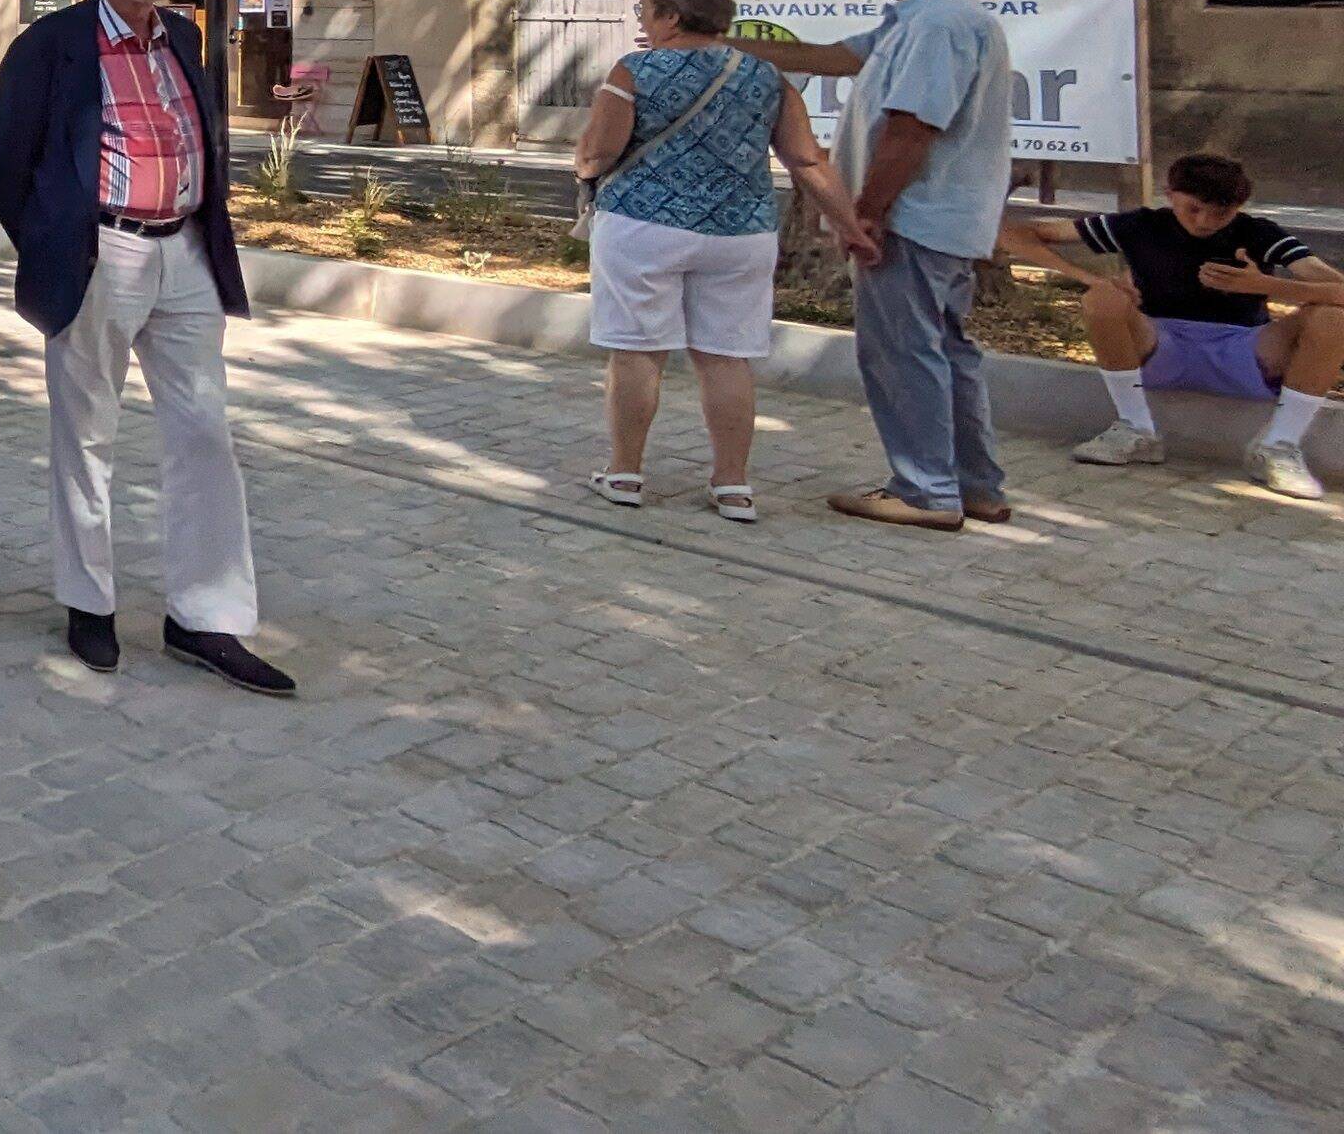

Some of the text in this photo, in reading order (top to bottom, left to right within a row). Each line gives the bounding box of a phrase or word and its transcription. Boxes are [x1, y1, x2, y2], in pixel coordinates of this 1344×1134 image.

[740, 3, 838, 17] RAVAUX
[1023, 138, 1044, 151] 70
[1046, 140, 1066, 152] 62
[1070, 141, 1090, 153] 61
